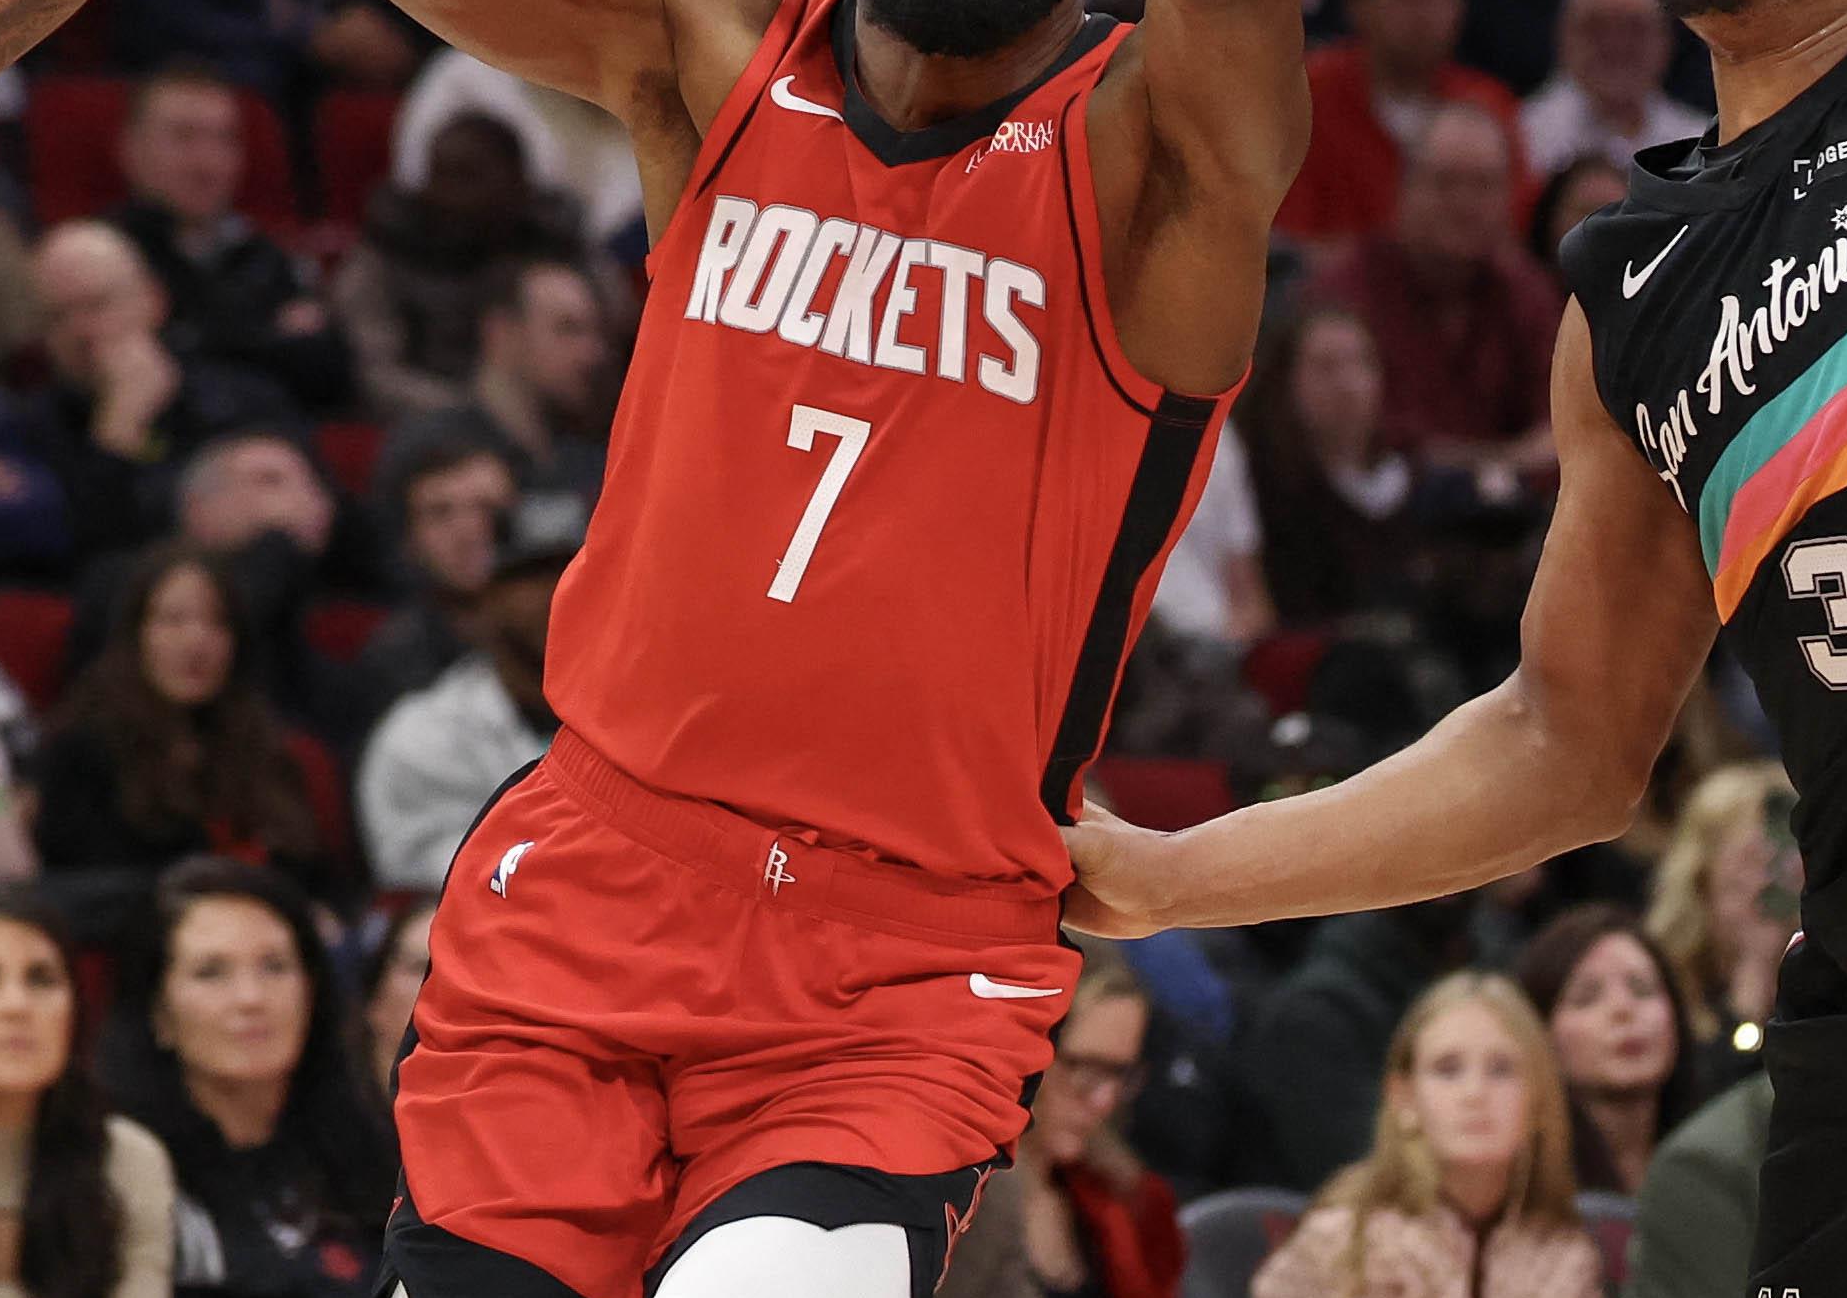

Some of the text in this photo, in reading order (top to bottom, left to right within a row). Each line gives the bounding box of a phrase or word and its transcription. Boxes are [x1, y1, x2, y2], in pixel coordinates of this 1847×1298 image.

[993, 118, 1054, 139] ORIAL
[683, 194, 1047, 405] ROCKETS
[766, 404, 872, 603] 7
